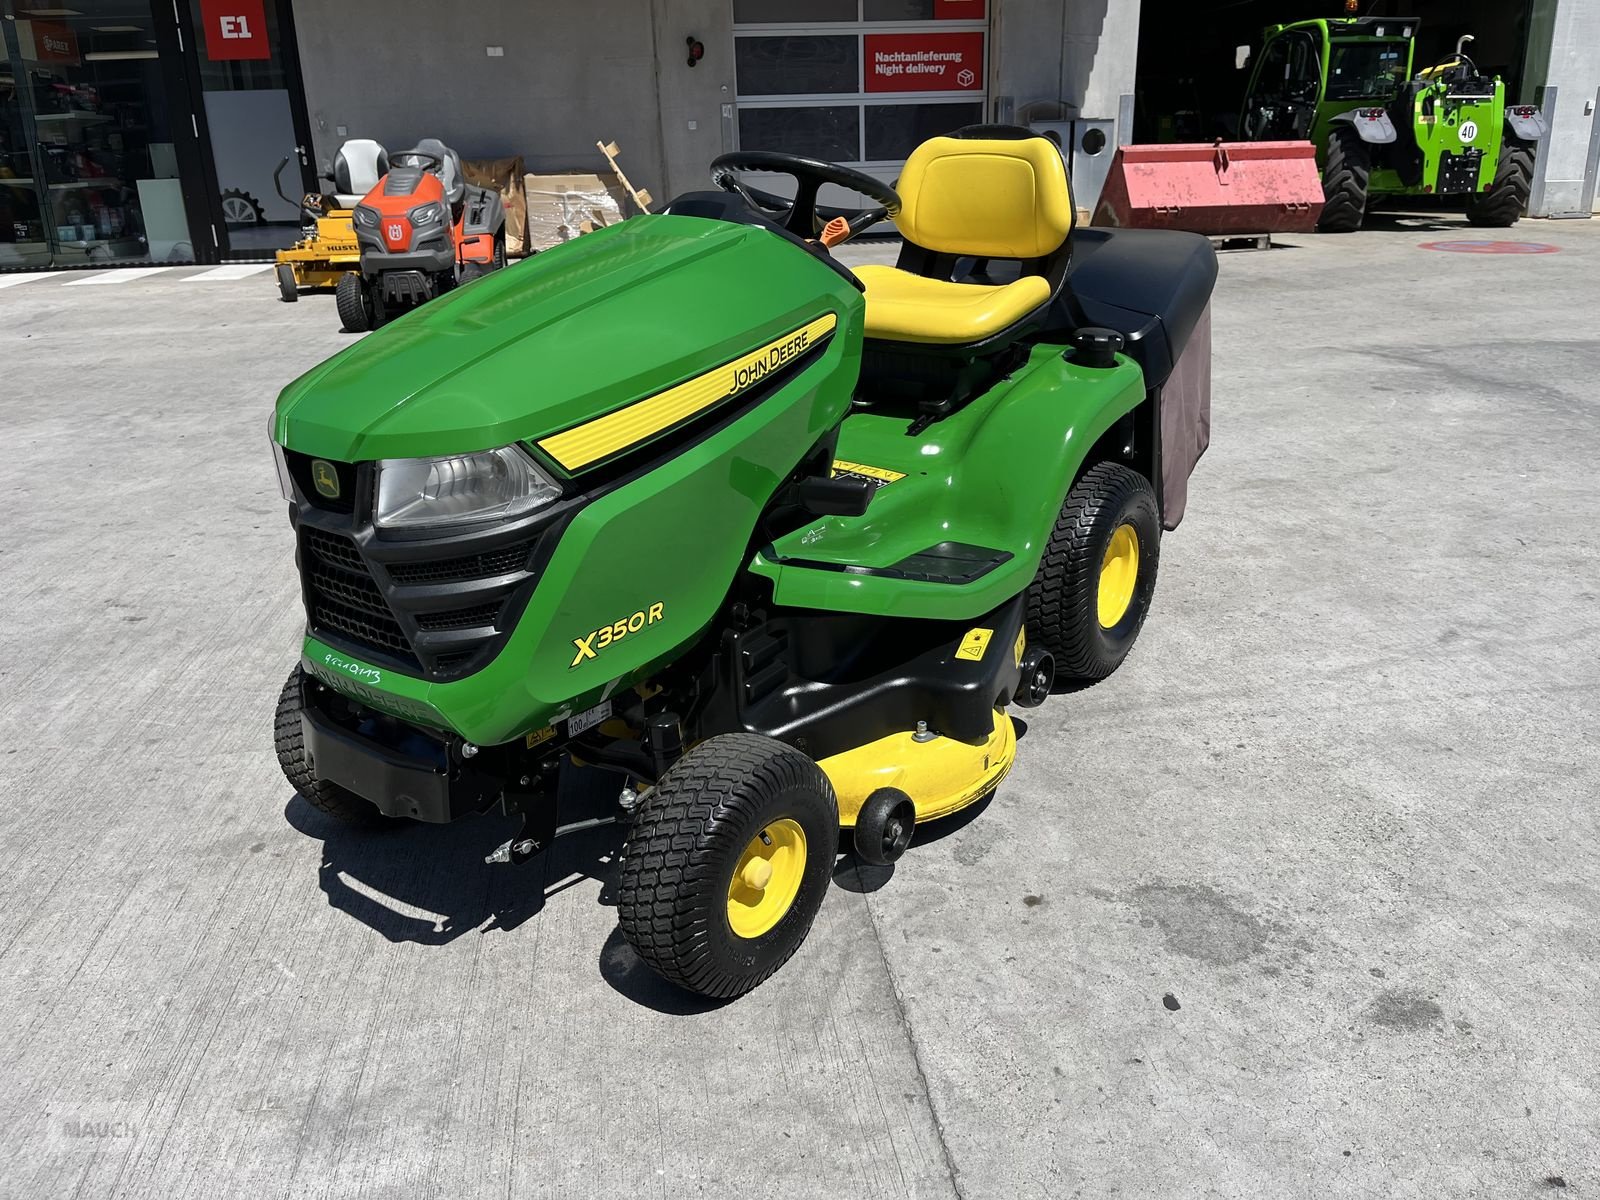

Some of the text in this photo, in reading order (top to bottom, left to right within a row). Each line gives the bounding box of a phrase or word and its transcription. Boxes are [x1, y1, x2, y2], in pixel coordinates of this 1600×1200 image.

[220, 16, 252, 39] E1
[875, 51, 962, 66] Nachtanlieferung
[875, 63, 946, 76] Night delivery
[1461, 125, 1475, 139] 40
[730, 331, 809, 392] JOHN DEERE
[569, 718, 583, 734] 100
